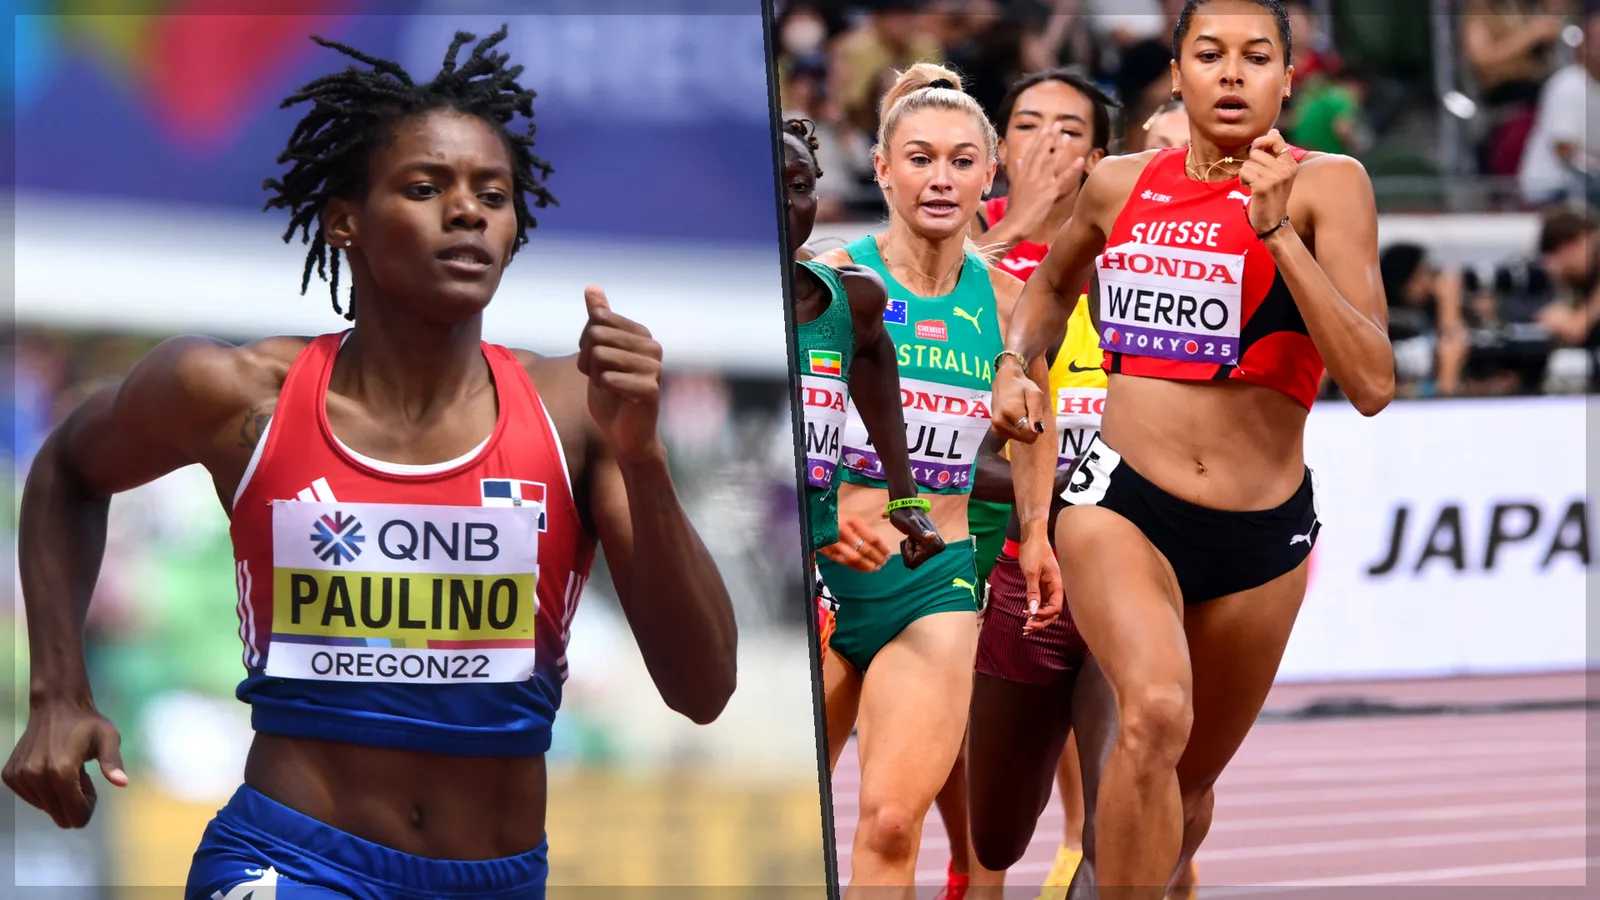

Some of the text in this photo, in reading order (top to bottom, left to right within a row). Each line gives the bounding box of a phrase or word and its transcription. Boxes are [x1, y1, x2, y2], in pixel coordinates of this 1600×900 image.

[1151, 193, 1172, 203] UBS
[1101, 253, 1237, 283] HONDA
[1107, 285, 1229, 329] WERRO
[897, 343, 992, 384] STRALIA
[803, 387, 846, 413] DA
[900, 388, 992, 419] ONDA
[866, 423, 962, 459] ULL
[1069, 450, 1101, 493] 5
[377, 519, 500, 561] QNB
[291, 573, 519, 631] PAULINO
[311, 651, 490, 679] OREGON22
